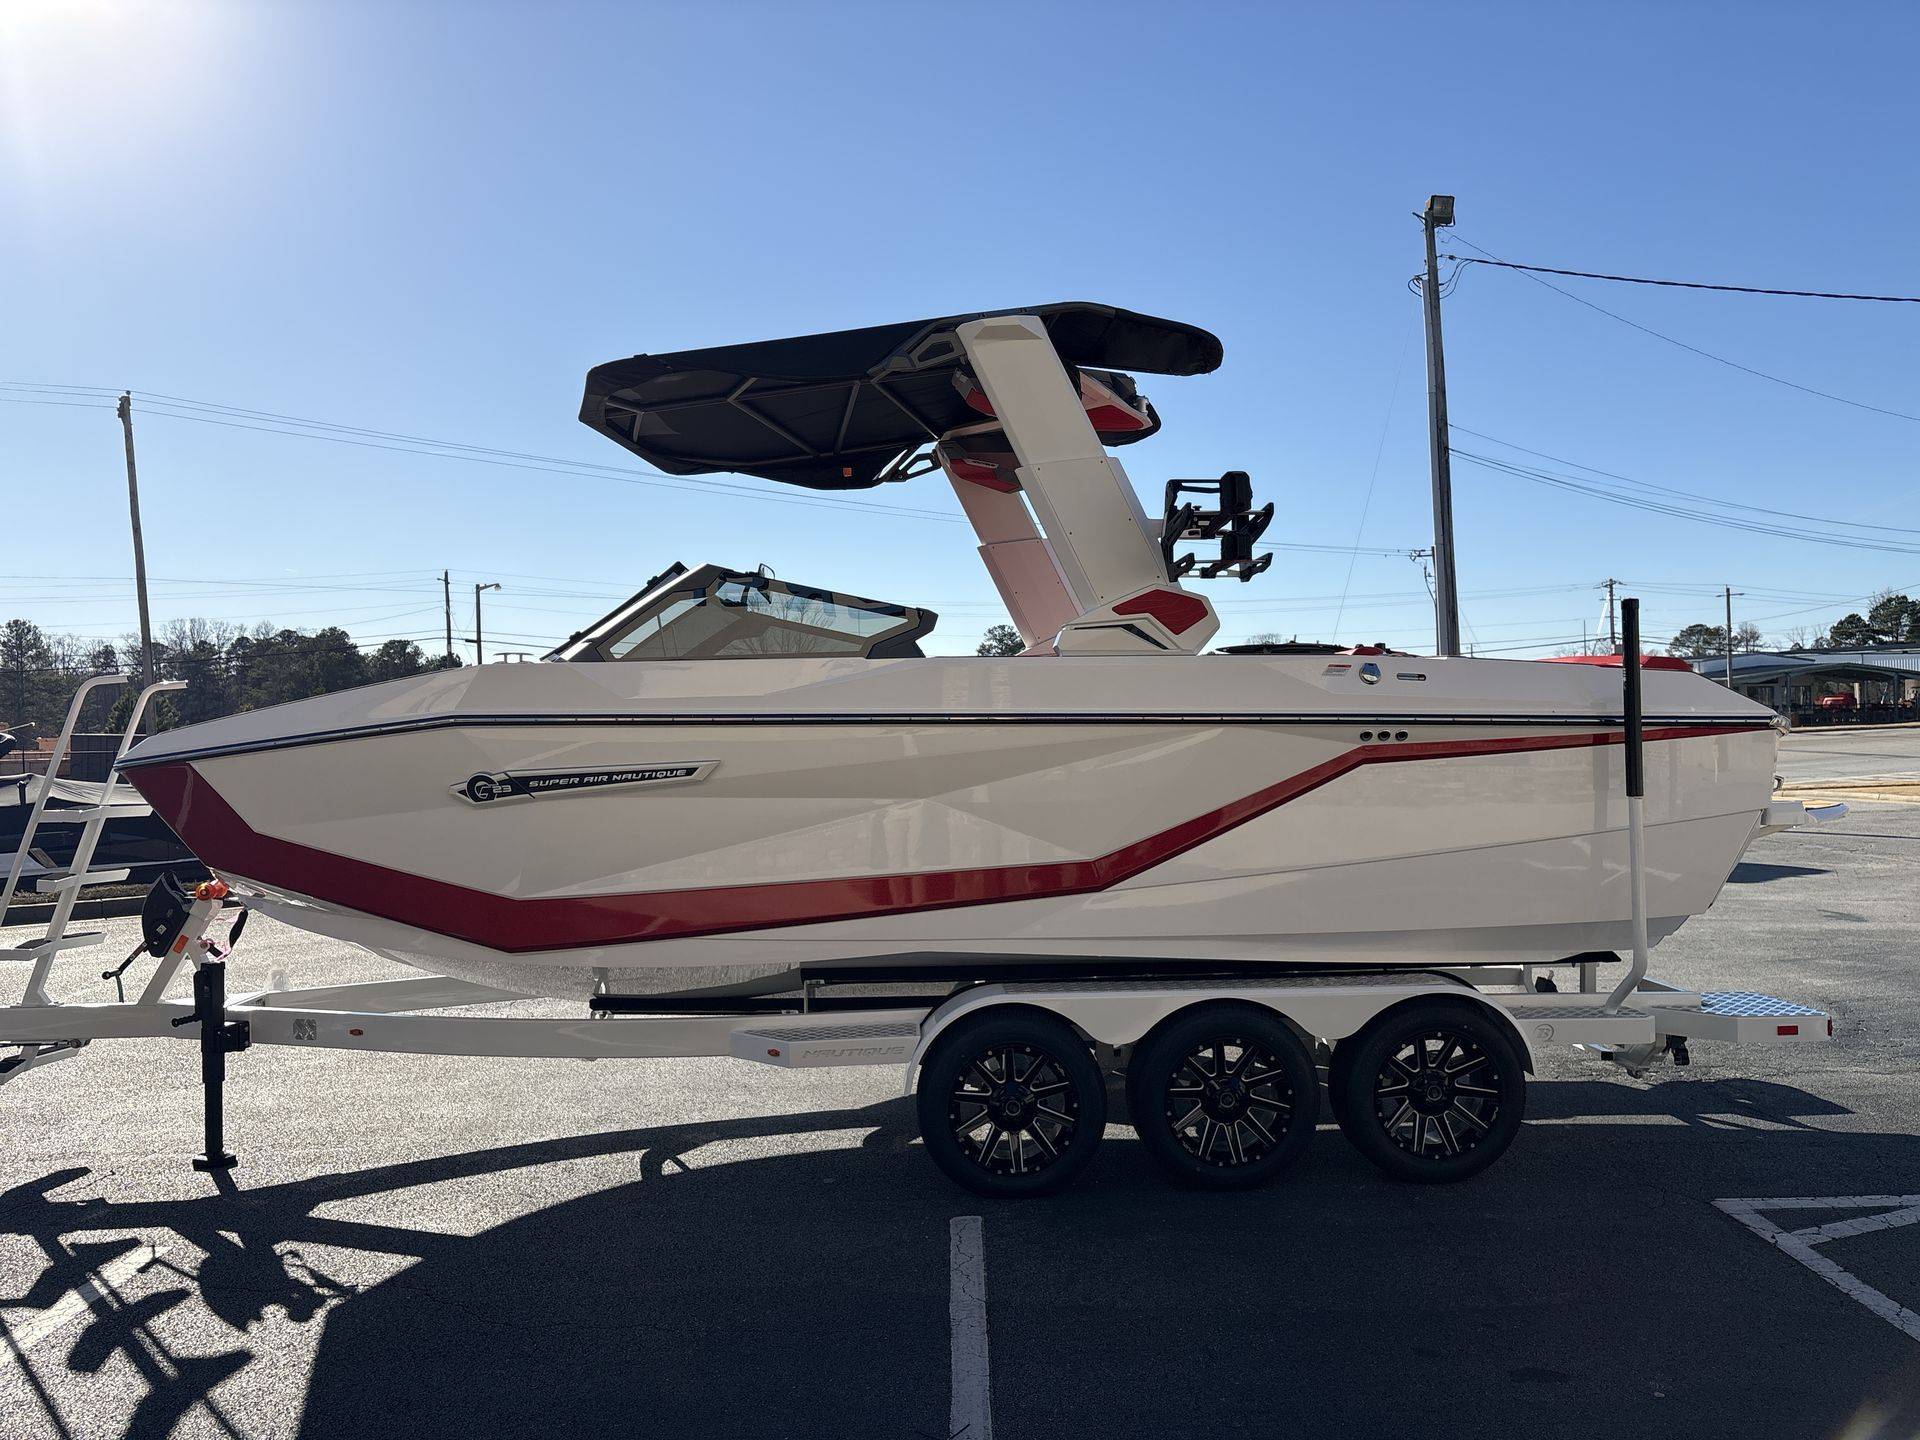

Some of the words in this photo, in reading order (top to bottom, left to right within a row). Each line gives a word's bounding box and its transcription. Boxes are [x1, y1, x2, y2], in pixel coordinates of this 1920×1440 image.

[528, 777, 580, 788] SUPER
[583, 775, 609, 784] AIR
[612, 769, 687, 781] NAUTIQUE
[803, 1046, 906, 1059] NAUTIQUE
